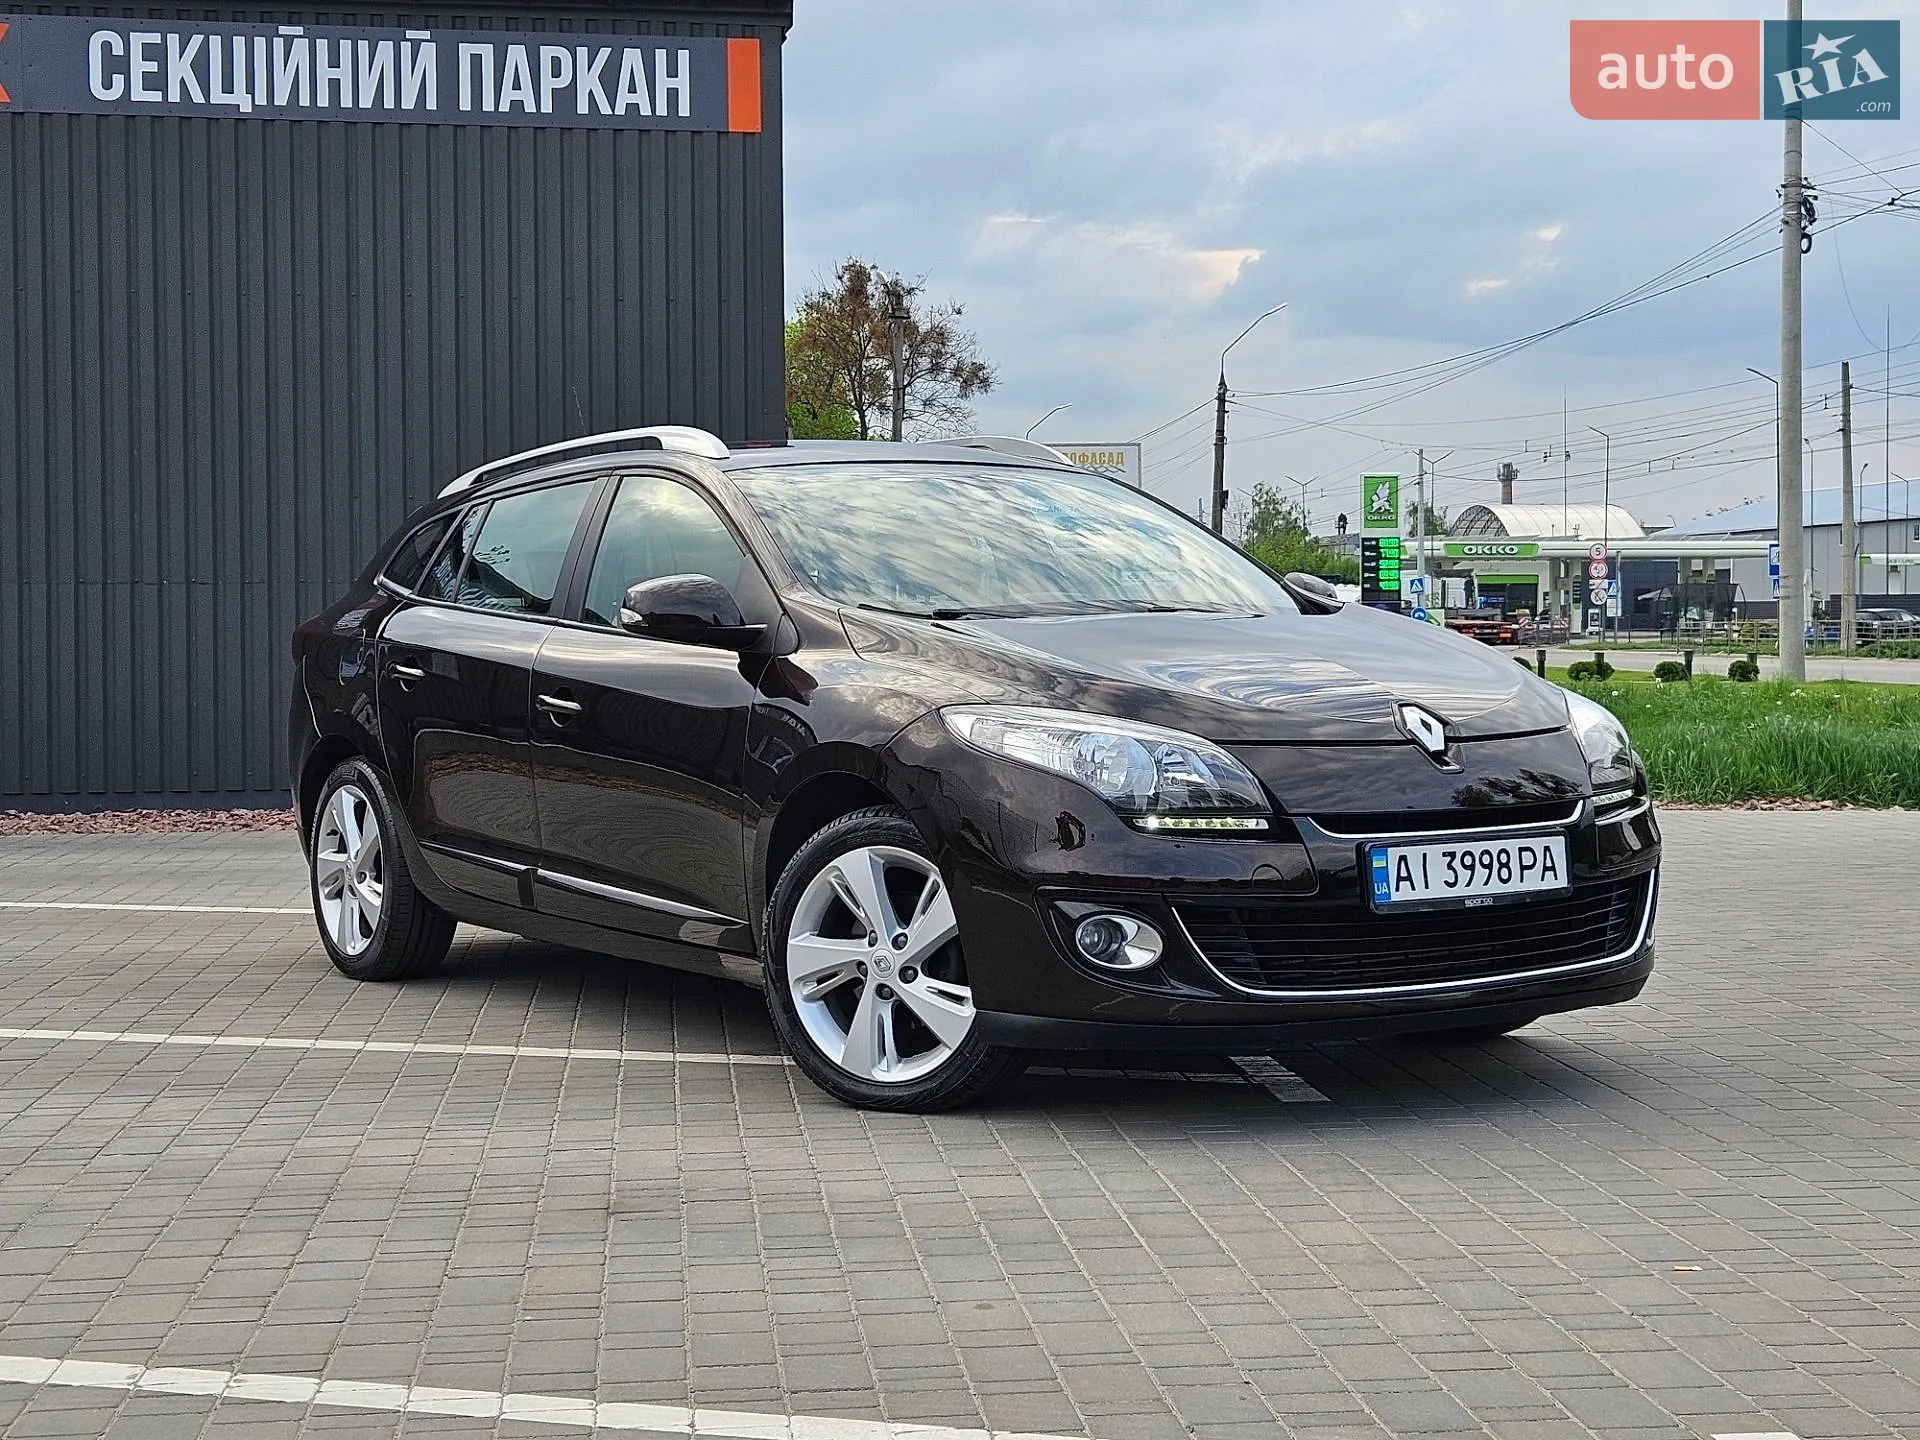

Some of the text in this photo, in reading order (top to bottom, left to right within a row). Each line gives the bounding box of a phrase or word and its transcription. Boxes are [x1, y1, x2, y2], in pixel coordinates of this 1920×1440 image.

[88, 25, 438, 113] СЕКЦІЙНИЙ
[458, 43, 692, 118] ПАРКАН
[1463, 545, 1519, 555] OKKO
[1595, 547, 1601, 556] 5
[1374, 882, 1389, 894] UA
